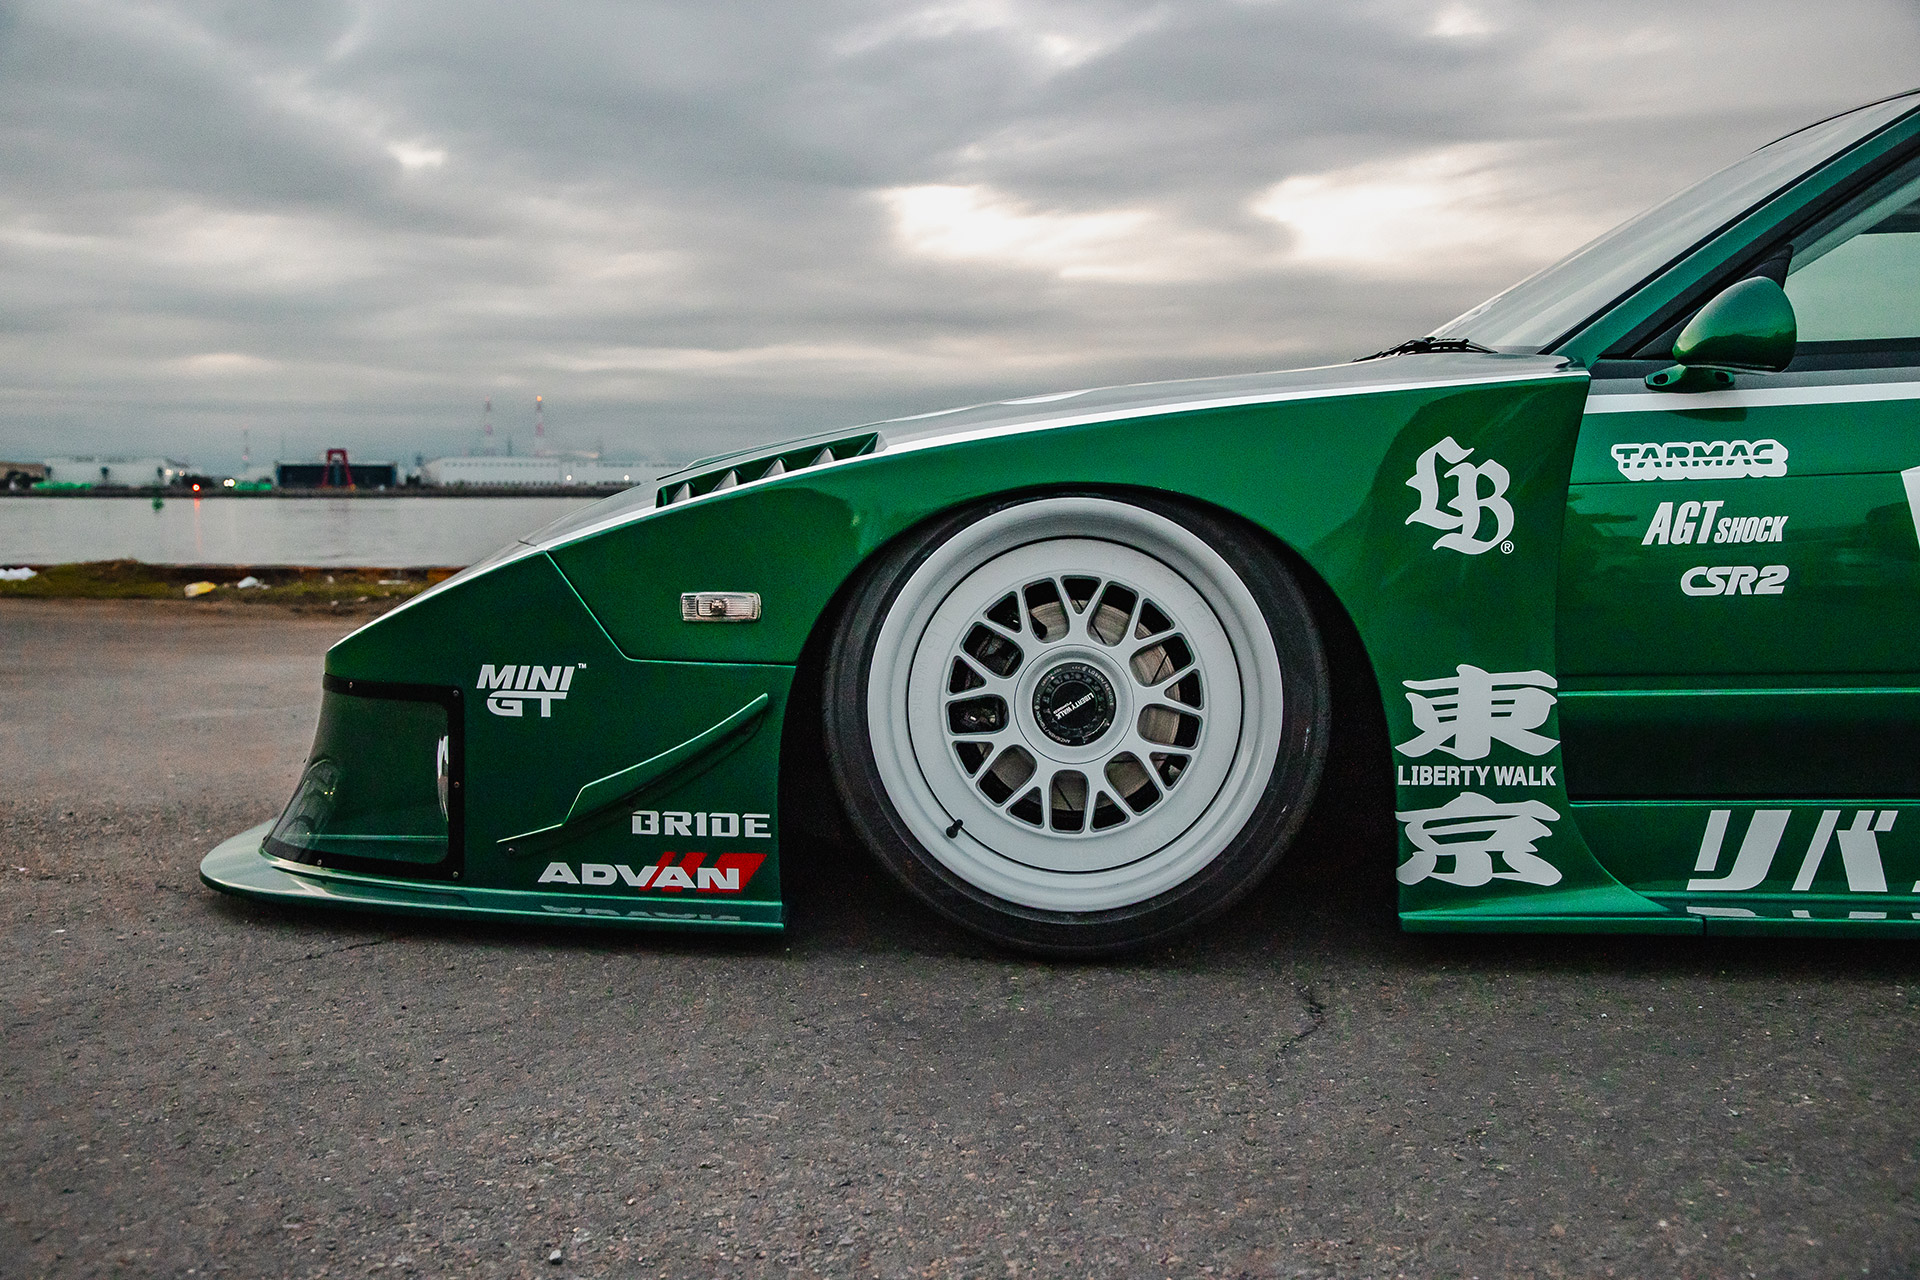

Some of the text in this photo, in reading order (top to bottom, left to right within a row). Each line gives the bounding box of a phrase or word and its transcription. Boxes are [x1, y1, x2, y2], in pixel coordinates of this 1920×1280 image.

[1611, 438, 1789, 481] TARMAC
[1641, 500, 1789, 546] AGT SHOCK
[1680, 565, 1790, 597] CSR2
[476, 664, 575, 691] MINI
[486, 690, 568, 718] GT
[1394, 663, 1561, 761] 東
[1397, 765, 1557, 786] LIBERTY WALK
[631, 810, 772, 838] BRIDE
[1394, 791, 1563, 887] 京
[1686, 809, 1920, 893] リバ
[537, 862, 740, 890] ADVAN
